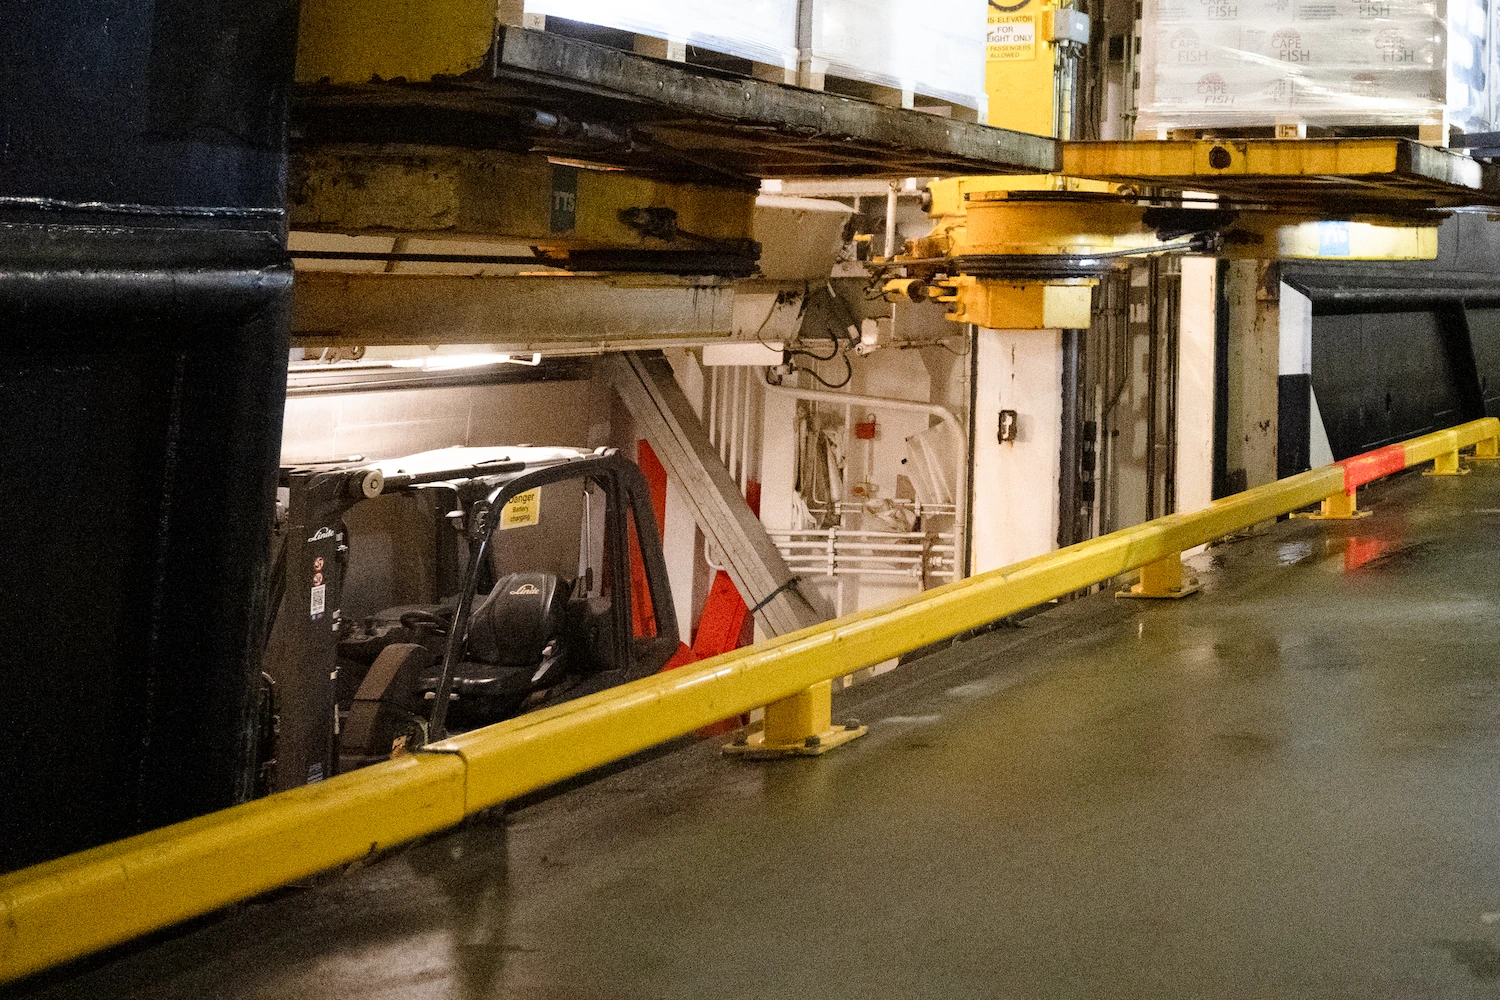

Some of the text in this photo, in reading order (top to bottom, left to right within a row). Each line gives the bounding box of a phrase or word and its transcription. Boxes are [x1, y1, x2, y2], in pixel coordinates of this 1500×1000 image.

[1207, 5, 1238, 18] FISH
[1359, 3, 1391, 17] FISH
[997, 15, 1033, 23] ELEVATOR
[987, 34, 1033, 43] EIGHT ONLY
[1170, 38, 1201, 50] CAPE
[1271, 38, 1302, 49] CAPE
[990, 44, 1031, 52] PASSENGERS
[990, 51, 1020, 59] ALLOWED
[1178, 49, 1209, 62] FISH
[1279, 49, 1311, 62] FISH
[1382, 50, 1415, 63] FISH
[1196, 84, 1228, 95] CAPE
[1204, 94, 1236, 104] FISH
[509, 583, 540, 595] Linde
